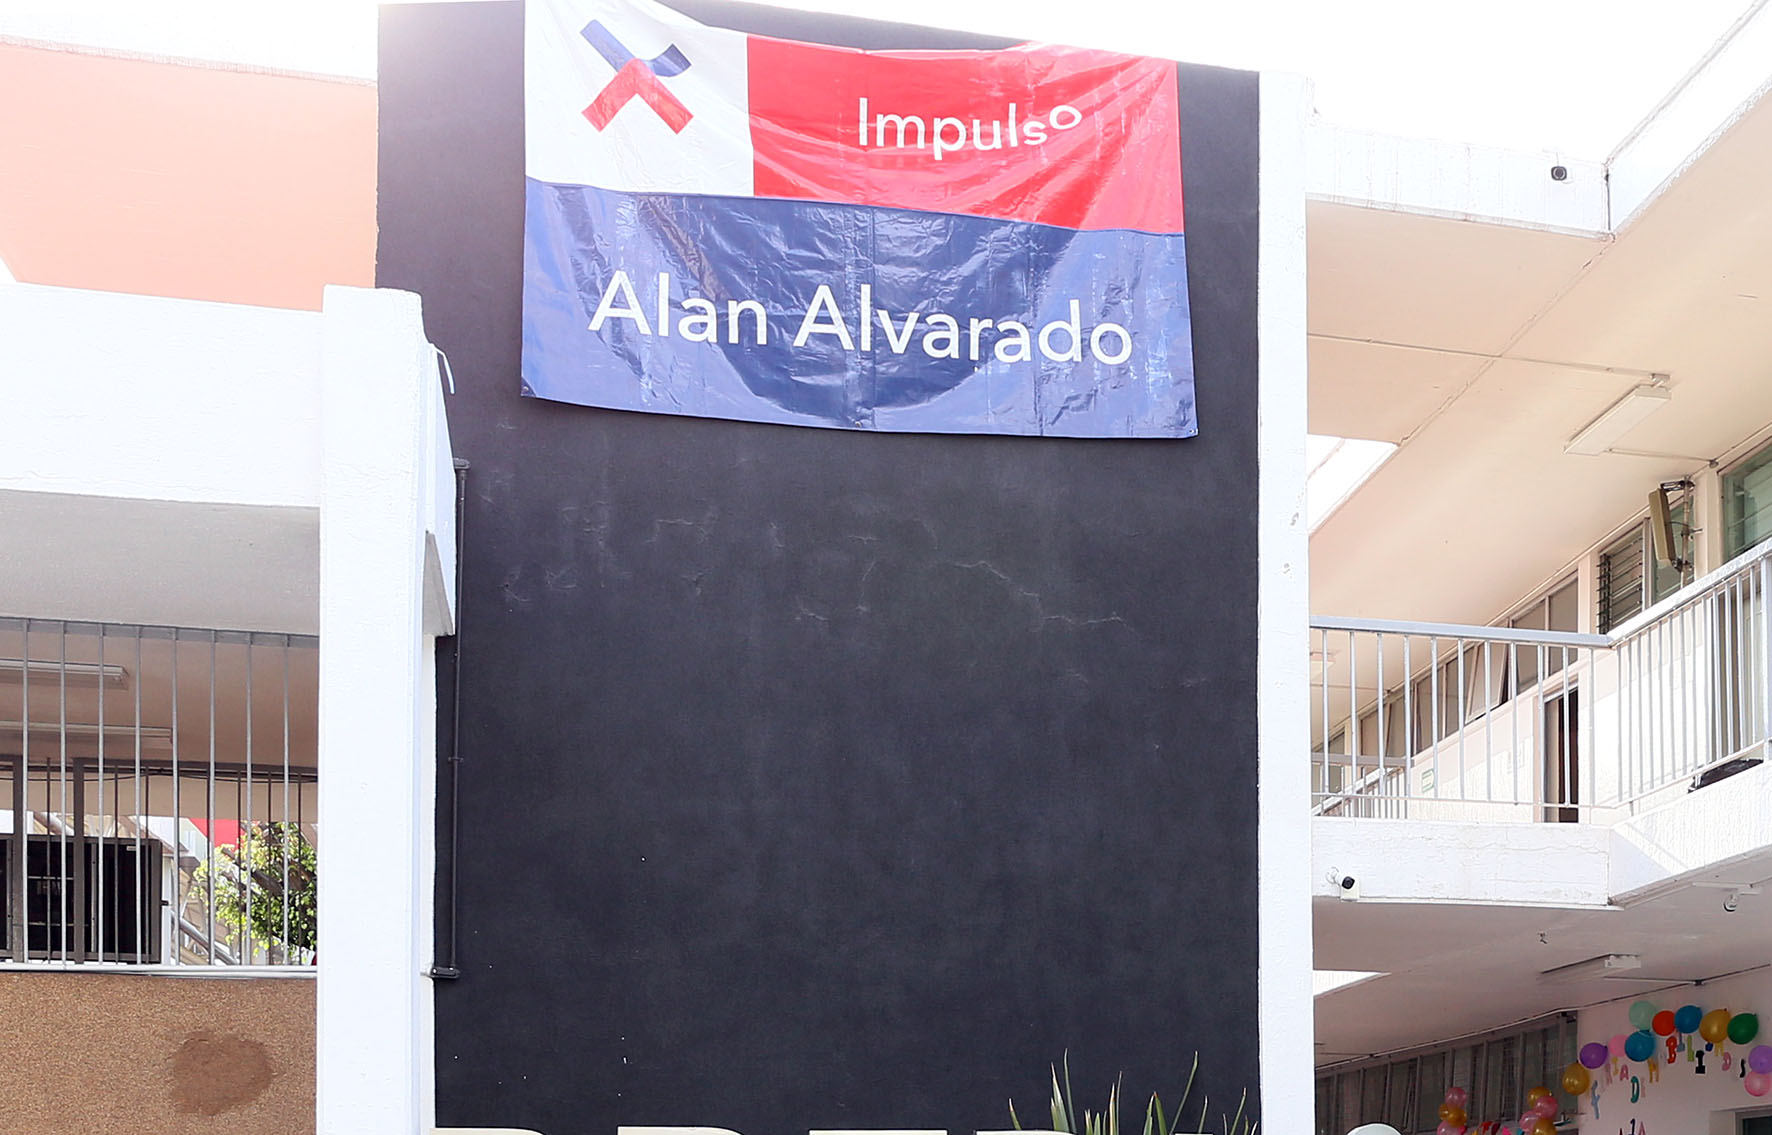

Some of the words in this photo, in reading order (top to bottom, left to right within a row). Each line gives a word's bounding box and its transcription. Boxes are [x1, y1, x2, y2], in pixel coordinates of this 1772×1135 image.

[858, 97, 1082, 160] Impulso
[587, 270, 768, 346] Alan
[793, 284, 1132, 365] Alvarado
